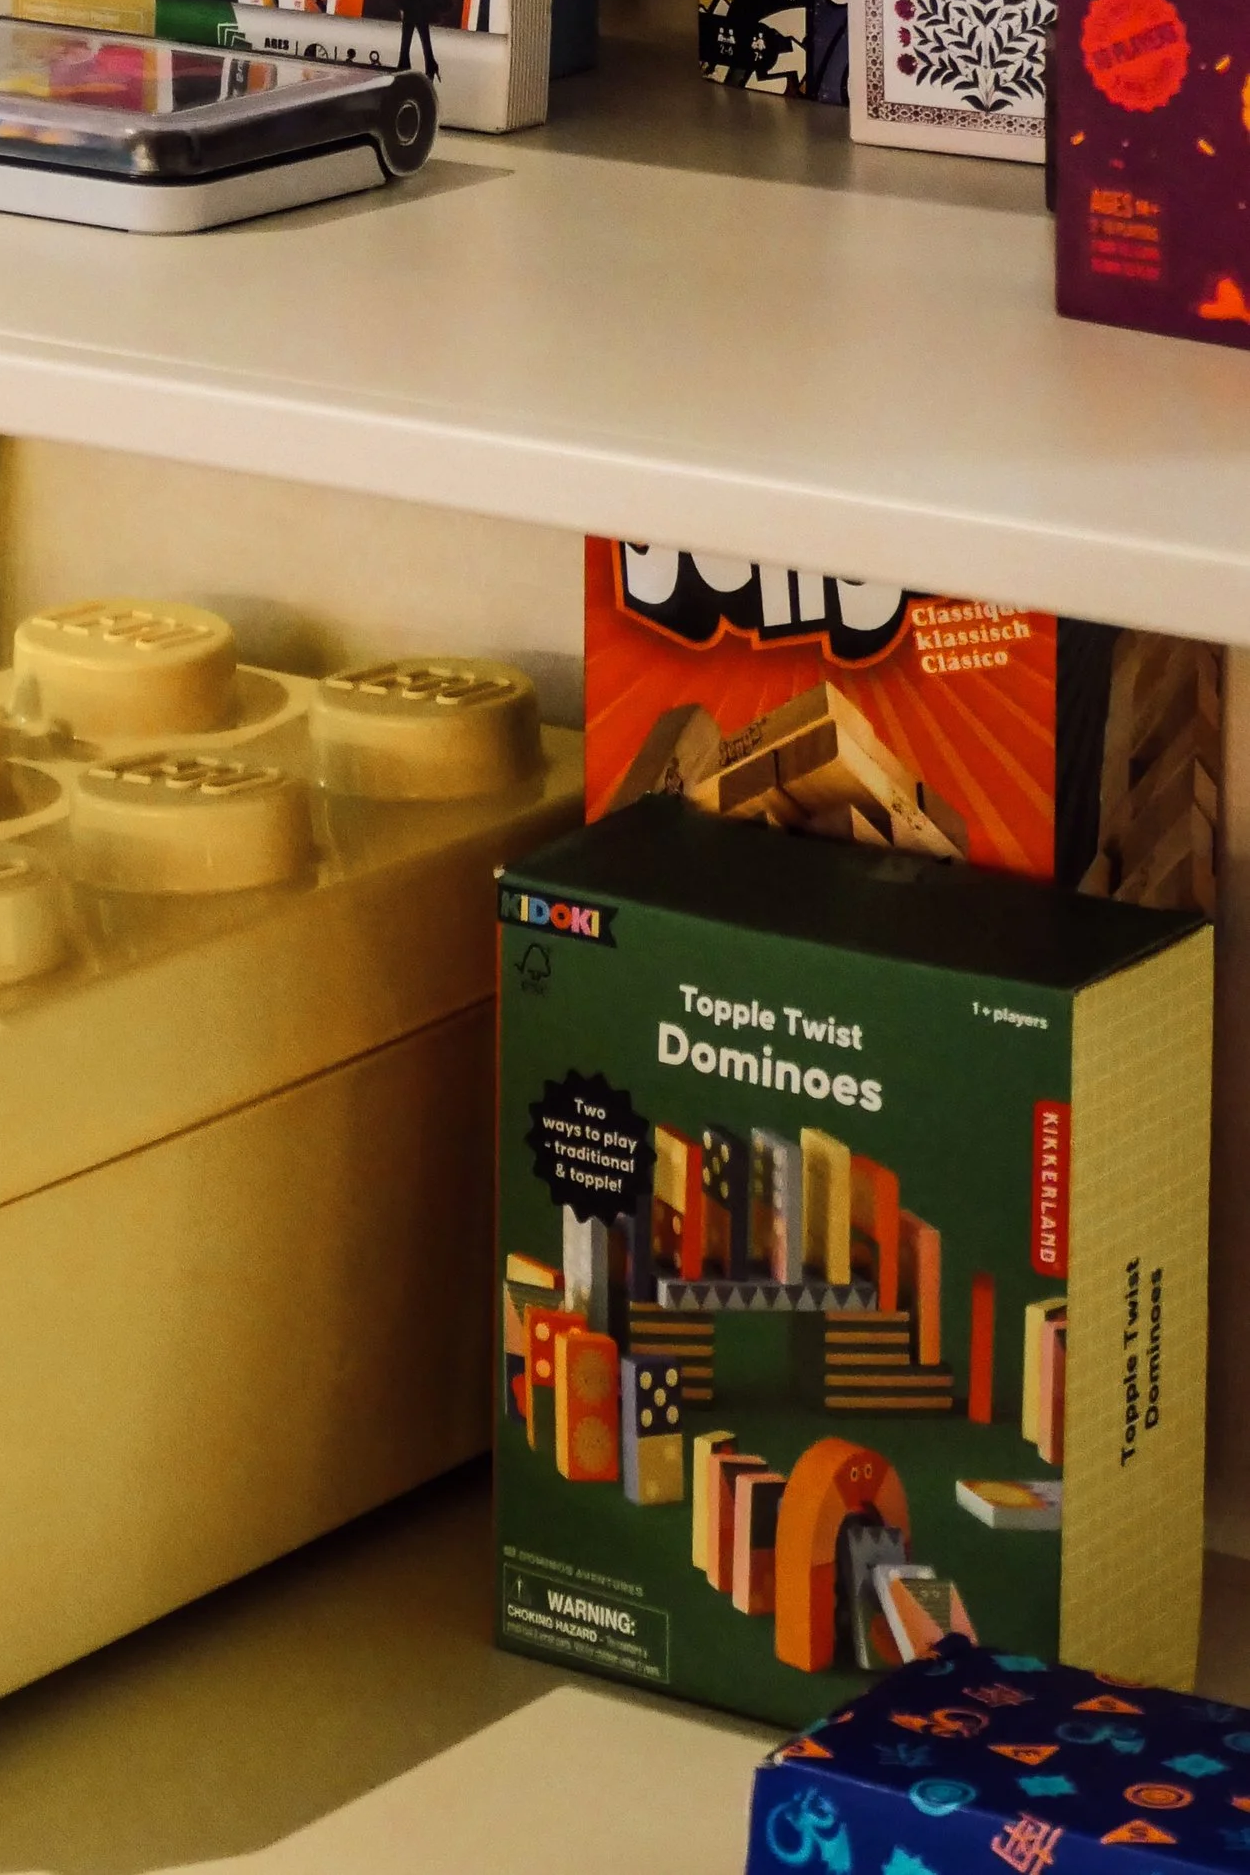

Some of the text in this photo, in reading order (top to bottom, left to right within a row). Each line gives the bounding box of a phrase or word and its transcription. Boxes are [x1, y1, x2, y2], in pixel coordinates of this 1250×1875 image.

[263, 37, 290, 51] AGES
[915, 620, 1033, 651] klassisch
[920, 648, 1009, 675] Clásico
[500, 890, 600, 939] KIDOKI
[679, 984, 864, 1051] Topple Twist
[993, 1007, 1049, 1031] players
[658, 1022, 884, 1113] Dominoes
[574, 1096, 606, 1120] Two
[542, 1116, 639, 1154] ways to play
[554, 1140, 635, 1174] traditional
[555, 1163, 623, 1194] & topple!
[1039, 1111, 1061, 1265] KIKKERLAND
[1121, 1257, 1141, 1467] Topple Twist
[1145, 1267, 1163, 1431] Dominoes
[507, 1604, 553, 1630] CHOKING
[555, 1619, 598, 1644] HAZARD
[547, 1588, 636, 1638] WARNING:
